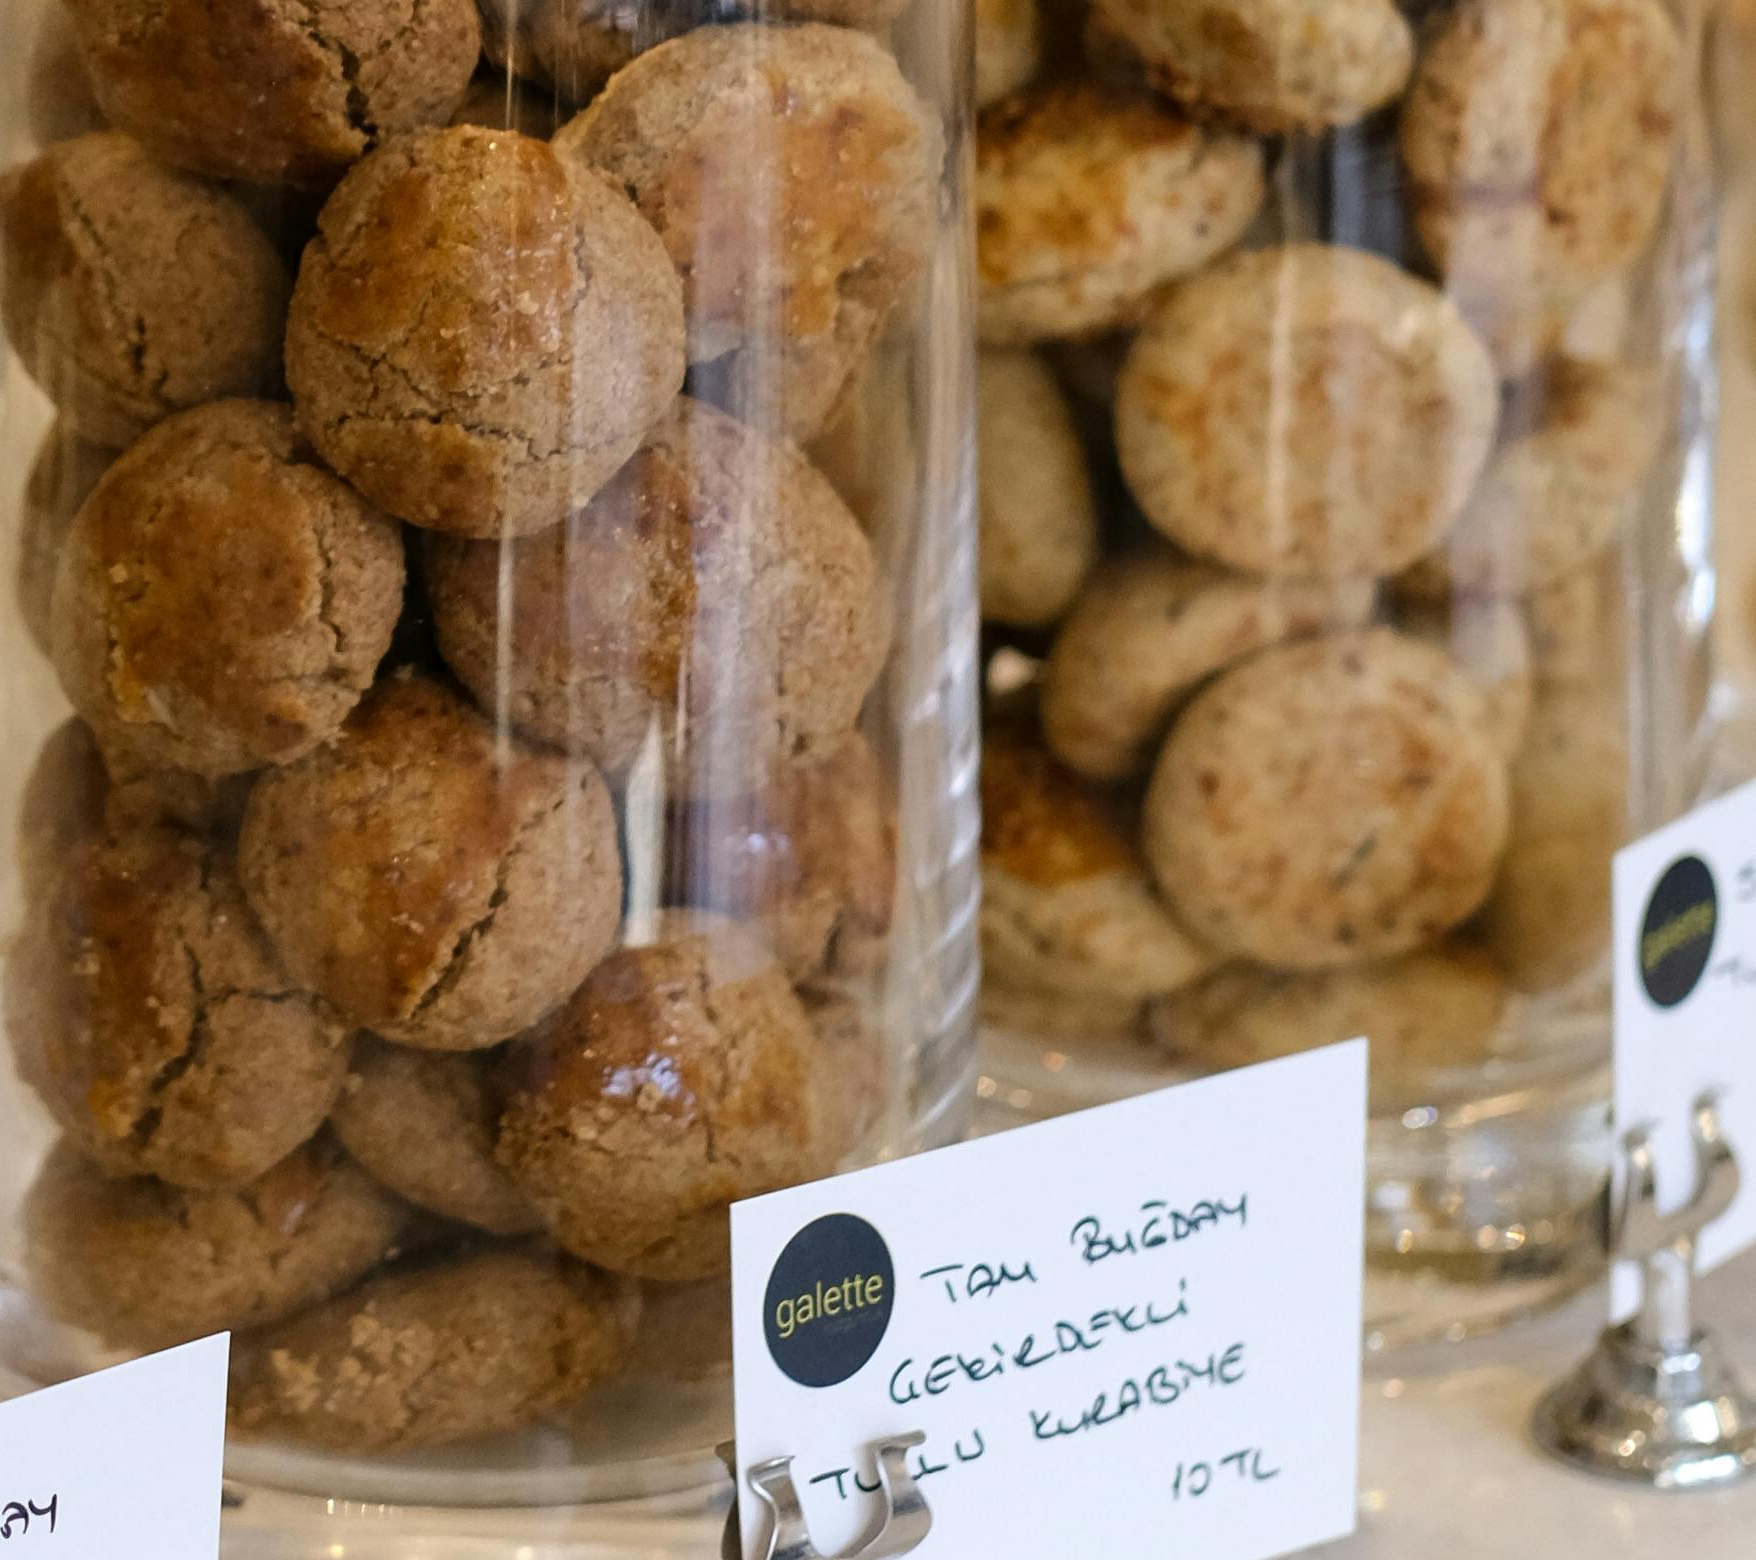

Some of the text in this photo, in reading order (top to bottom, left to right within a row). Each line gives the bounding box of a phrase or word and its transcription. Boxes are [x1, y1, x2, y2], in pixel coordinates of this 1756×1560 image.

[775, 1272, 885, 1339] galette
[918, 1259, 1039, 1305] TAM
[808, 1427, 986, 1502] TULU
[1170, 1447, 1282, 1501] 10 TL
